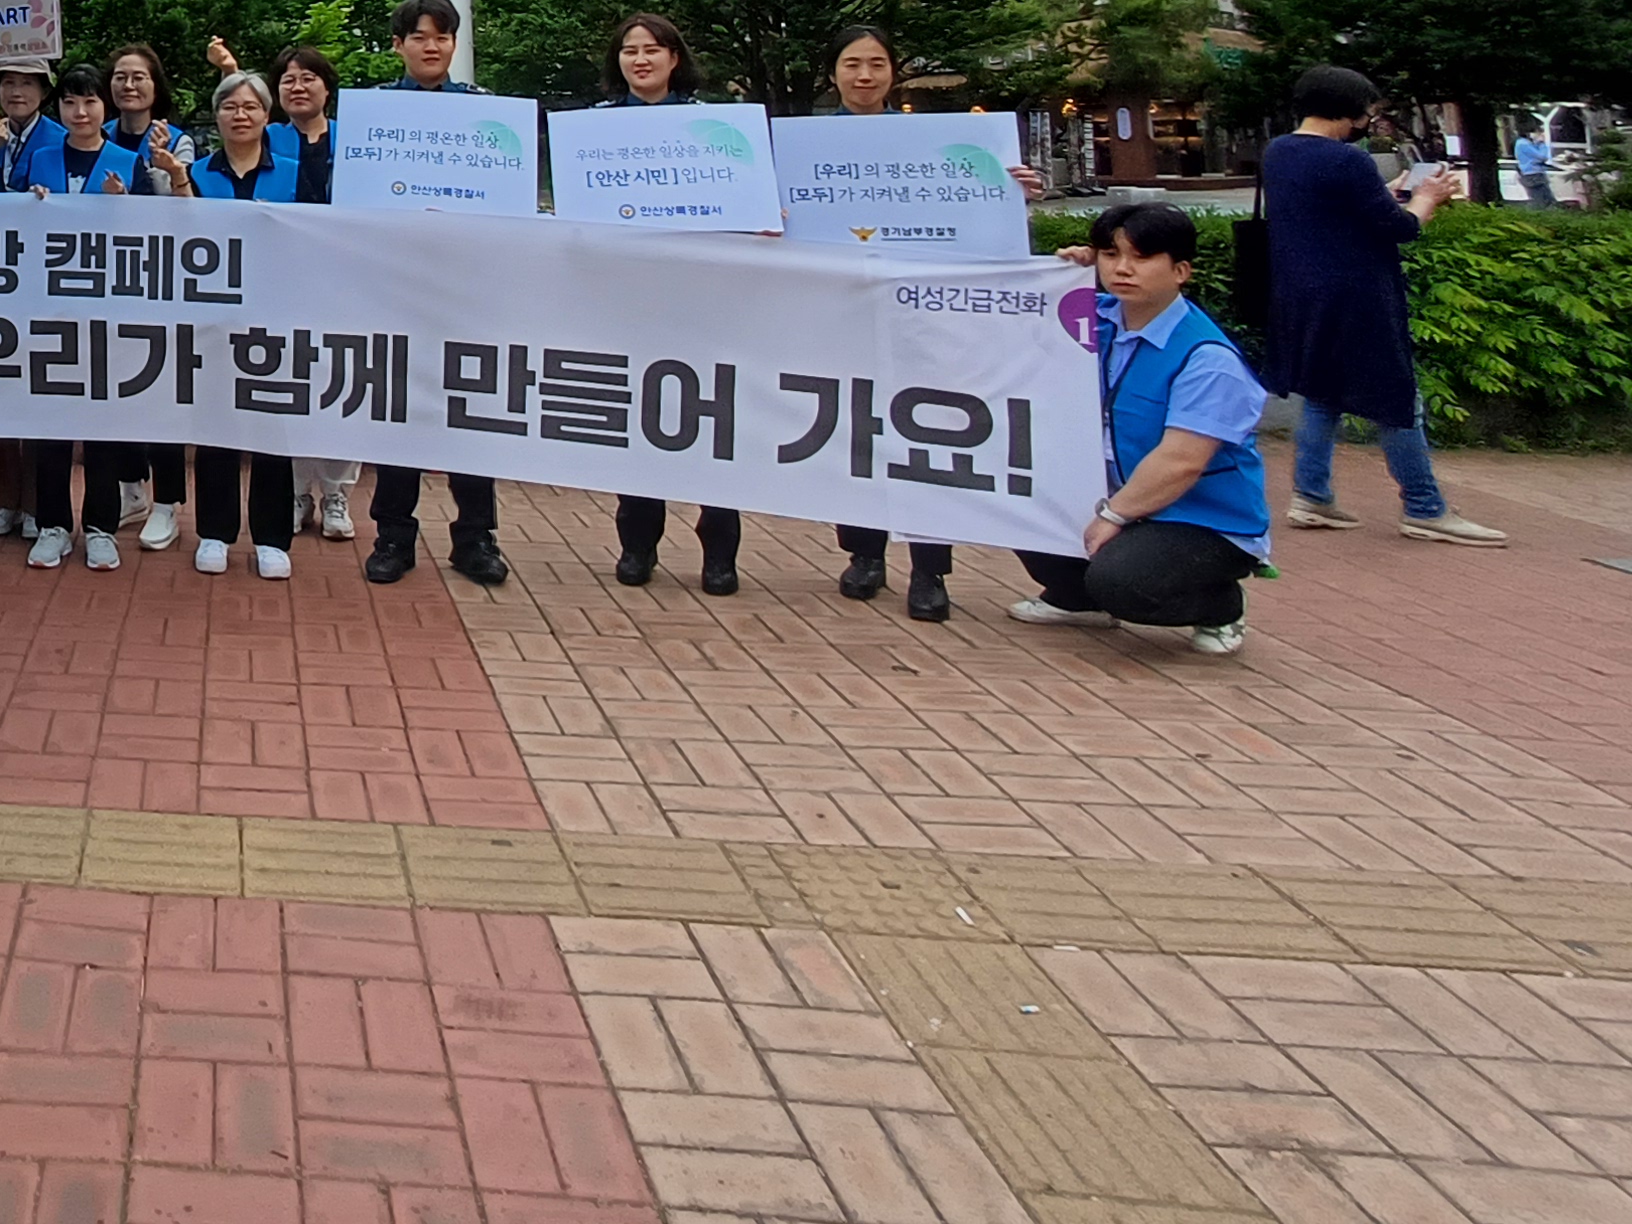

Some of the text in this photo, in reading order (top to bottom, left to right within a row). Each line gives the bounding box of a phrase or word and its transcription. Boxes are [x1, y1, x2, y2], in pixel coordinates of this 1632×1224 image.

[426, 132, 468, 147] 평온한
[404, 150, 444, 165] 지켜낼
[448, 153, 463, 165] 수
[466, 153, 525, 171] 있습니다.
[575, 143, 743, 162] 우리는 평온한 일상을 지키는
[884, 161, 936, 180] 평온한
[860, 185, 910, 204] 지켜낼
[915, 186, 932, 203] 수
[937, 184, 1011, 203] 있습니다.
[44, 230, 243, 305] 캠페인
[896, 284, 1048, 317] 여성긴급전화
[229, 326, 409, 423] 함께
[443, 340, 736, 461] 만들어
[777, 372, 1033, 497] 가요!
